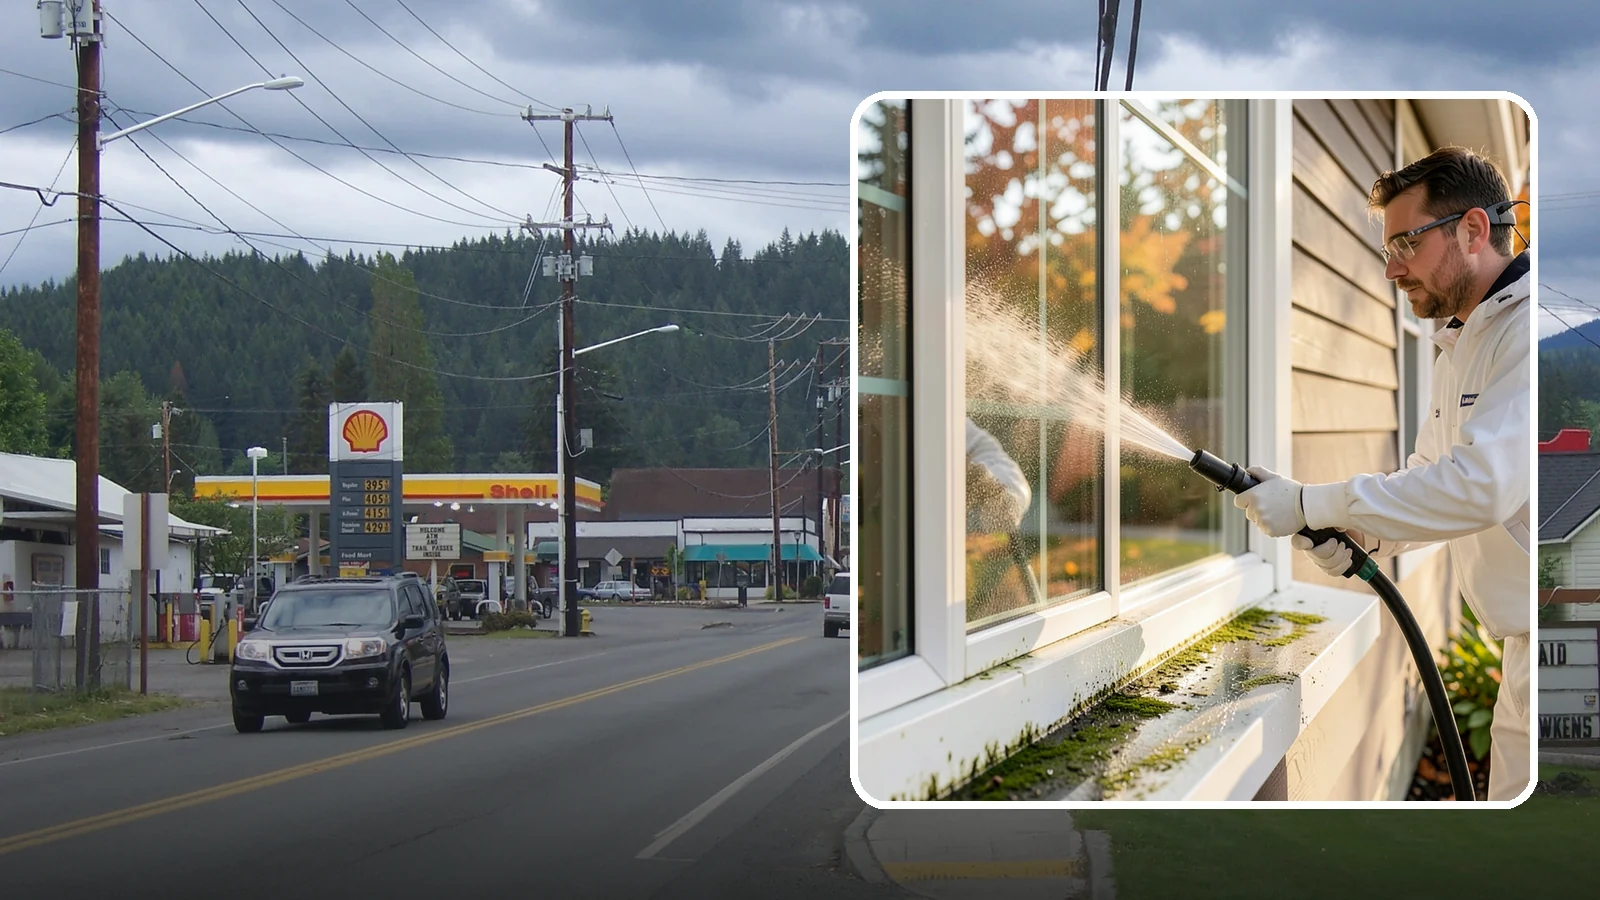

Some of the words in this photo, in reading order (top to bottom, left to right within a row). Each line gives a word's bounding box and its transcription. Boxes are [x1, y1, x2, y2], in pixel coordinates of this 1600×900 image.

[366, 480, 383, 490] 395
[490, 484, 547, 499] Shell
[366, 494, 383, 504] 405
[366, 508, 383, 518] 415
